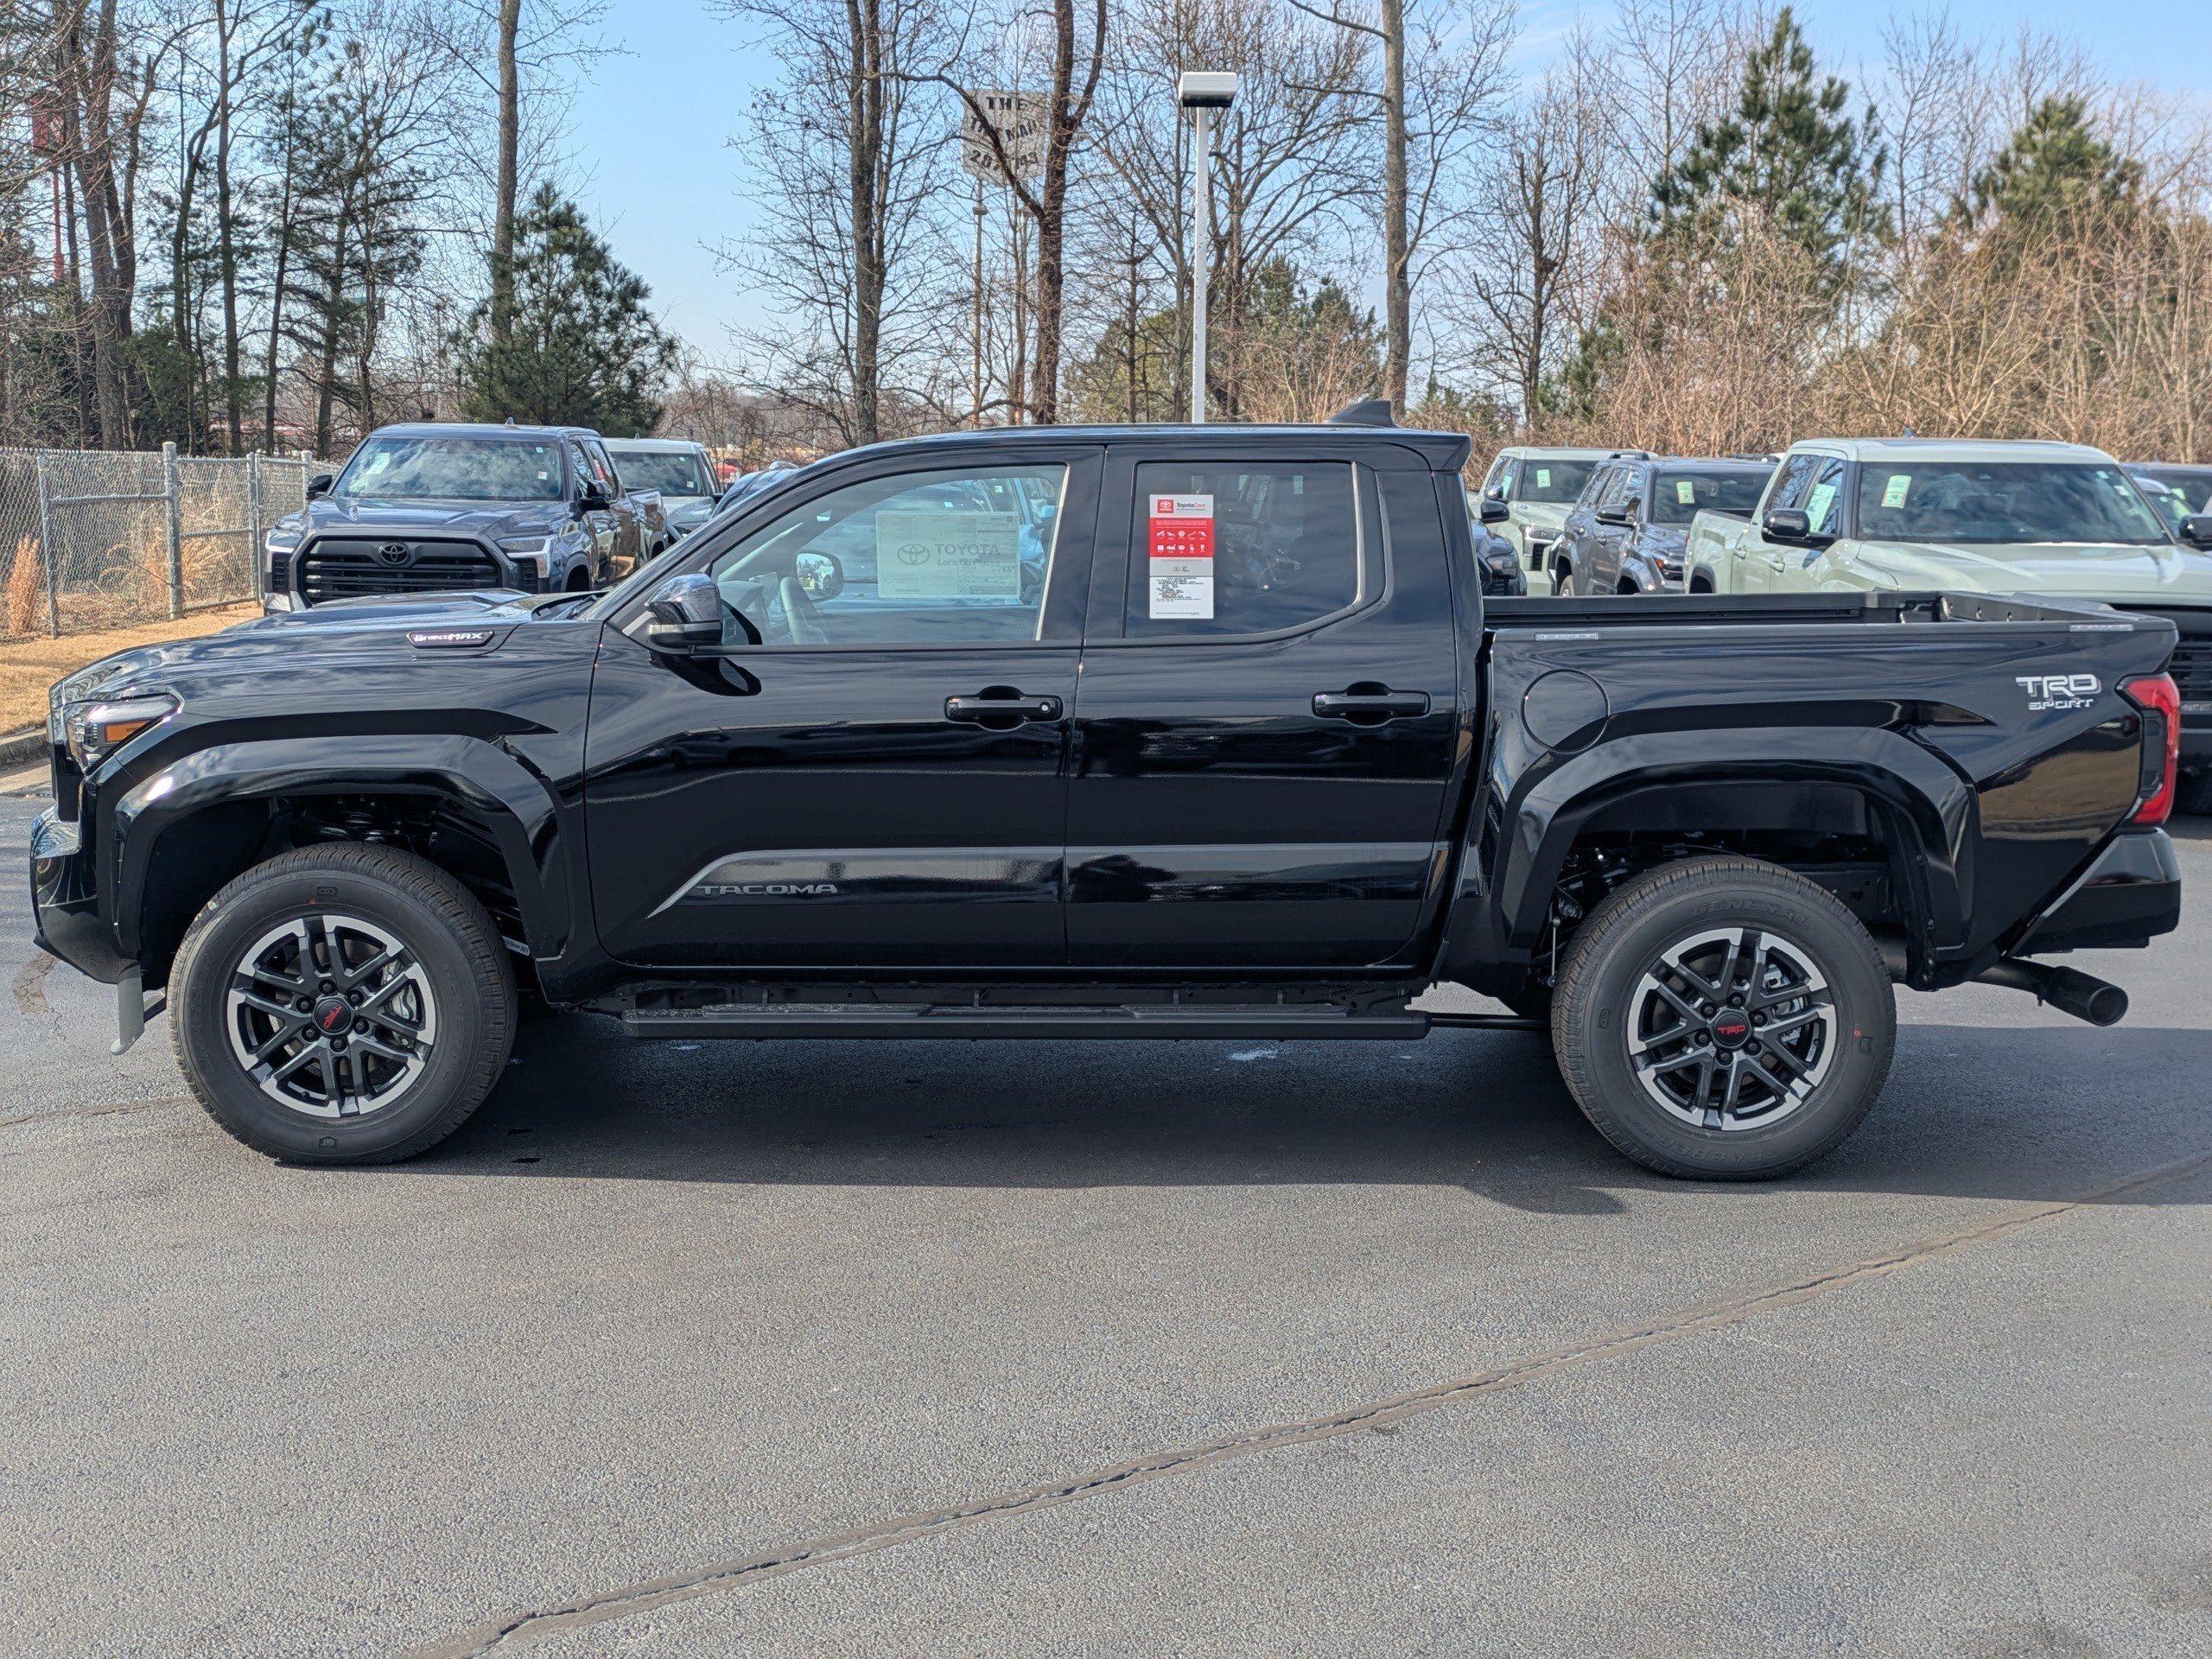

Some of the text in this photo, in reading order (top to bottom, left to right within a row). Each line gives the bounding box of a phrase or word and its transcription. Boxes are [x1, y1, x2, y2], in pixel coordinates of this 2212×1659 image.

[935, 543, 1001, 555] TOYOTA
[2016, 674, 2101, 698] TRD
[2028, 698, 2094, 710] SPORT
[696, 884, 838, 895] TACOMA
[1717, 1025, 1745, 1035] TRD
